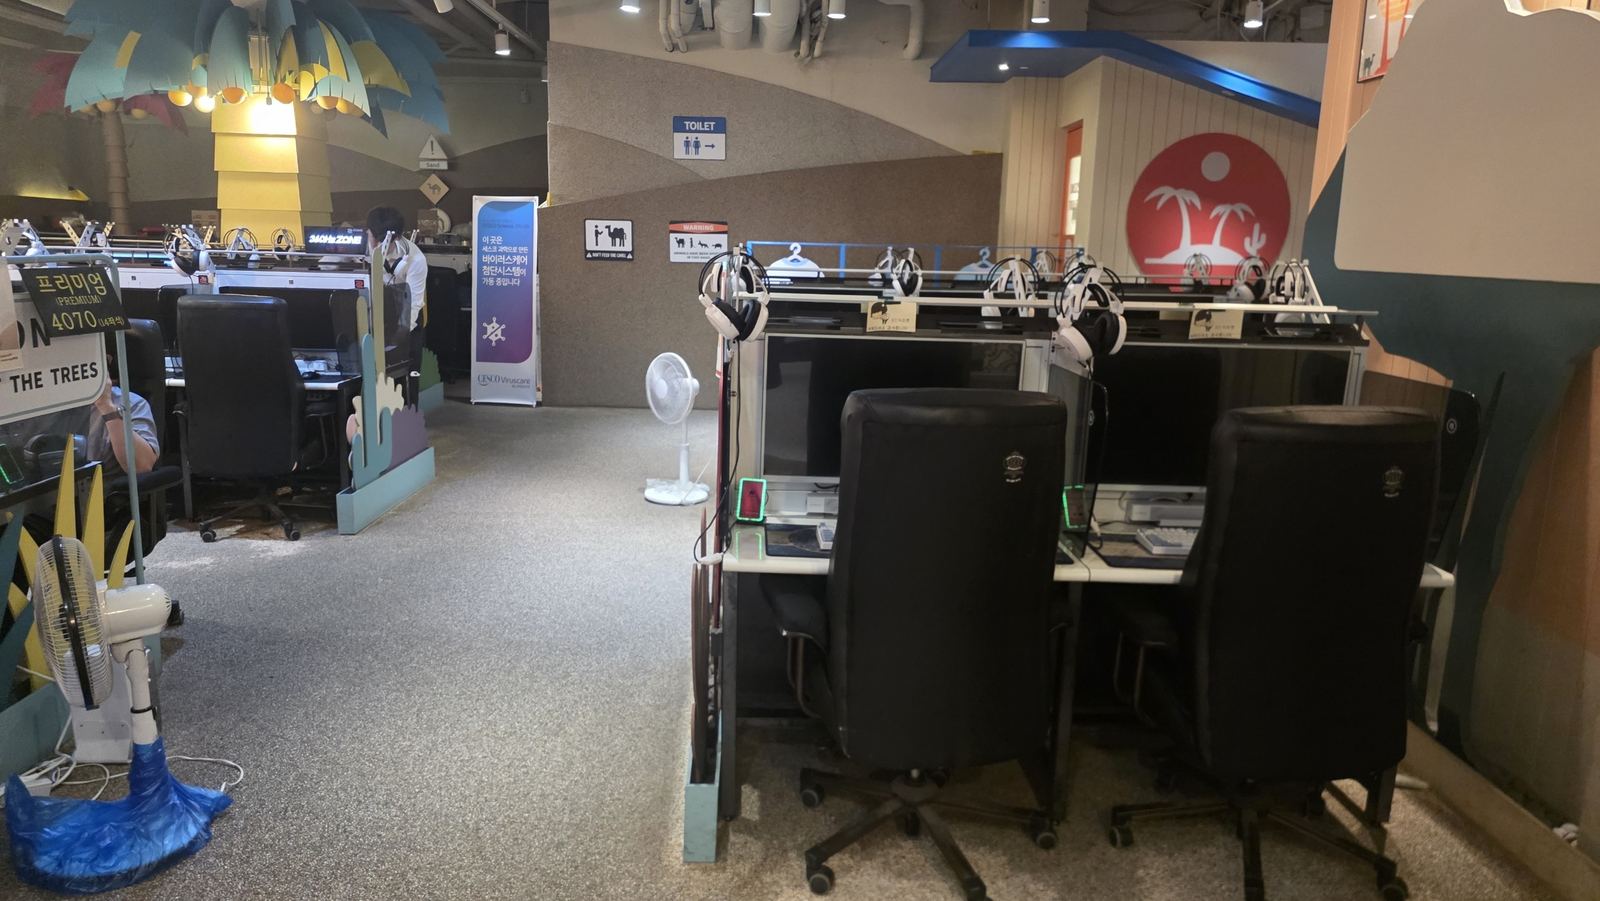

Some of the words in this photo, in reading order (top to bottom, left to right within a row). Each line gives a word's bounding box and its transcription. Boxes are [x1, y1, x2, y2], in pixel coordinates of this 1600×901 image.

[684, 121, 716, 131] TOILET
[335, 236, 362, 245] ZONE
[482, 235, 489, 244] 이
[482, 255, 528, 265] 바이러스케어
[482, 266, 526, 277] 첨단시스템이
[36, 273, 107, 296] 프리미엄
[495, 278, 520, 287] 중입니다
[56, 295, 102, 306] (PREMIUM)
[52, 310, 97, 330] 4070
[10, 371, 43, 393] THE
[50, 362, 98, 385] TREES
